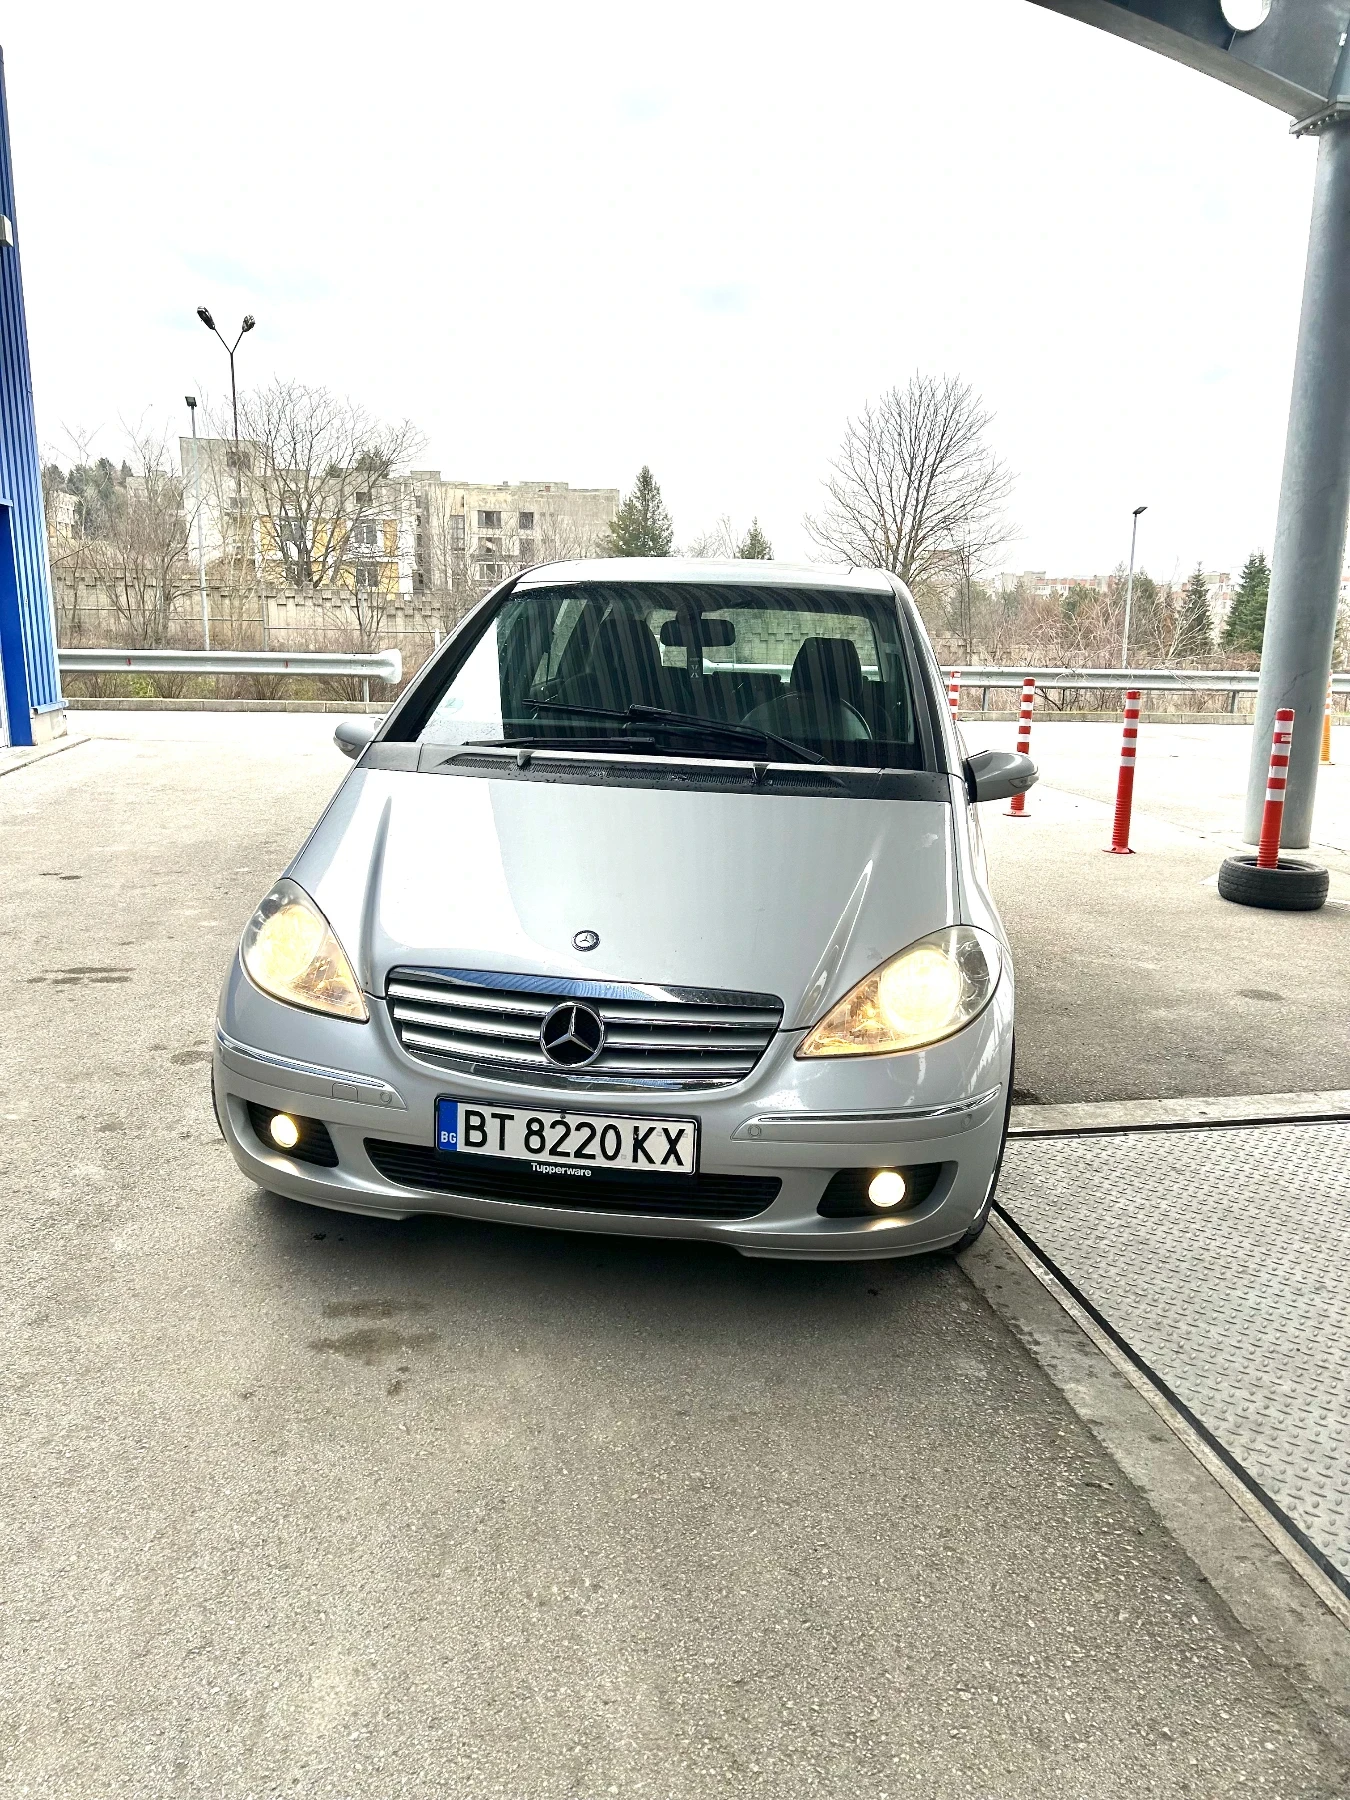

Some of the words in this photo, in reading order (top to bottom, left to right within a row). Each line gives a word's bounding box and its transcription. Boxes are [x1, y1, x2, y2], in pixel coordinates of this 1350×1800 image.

[440, 1131, 457, 1143] BG
[464, 1109, 515, 1151] BT
[524, 1117, 622, 1161] 8220
[631, 1125, 686, 1166] KX
[531, 1162, 592, 1177] Tupperware
